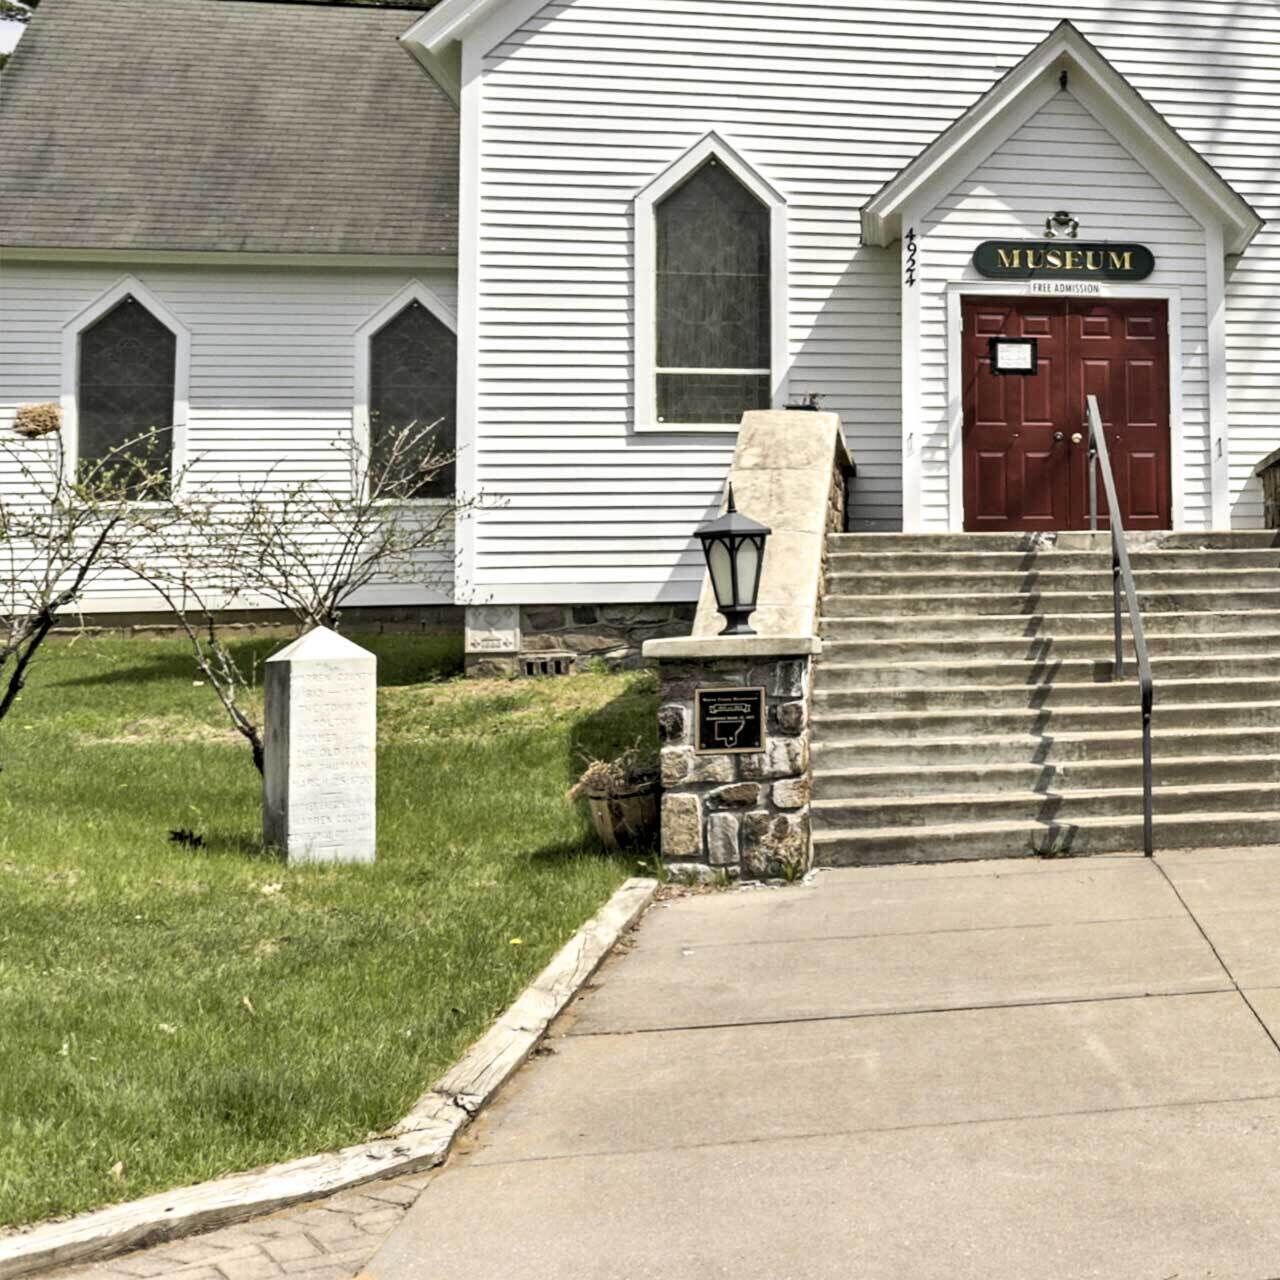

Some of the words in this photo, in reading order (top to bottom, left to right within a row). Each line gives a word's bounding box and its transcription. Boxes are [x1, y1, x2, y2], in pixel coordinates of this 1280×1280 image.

[904, 227, 916, 287] 4924
[997, 249, 1135, 270] MUSEUM
[1033, 282, 1051, 293] FREE
[1054, 283, 1100, 294] ADMISSION
